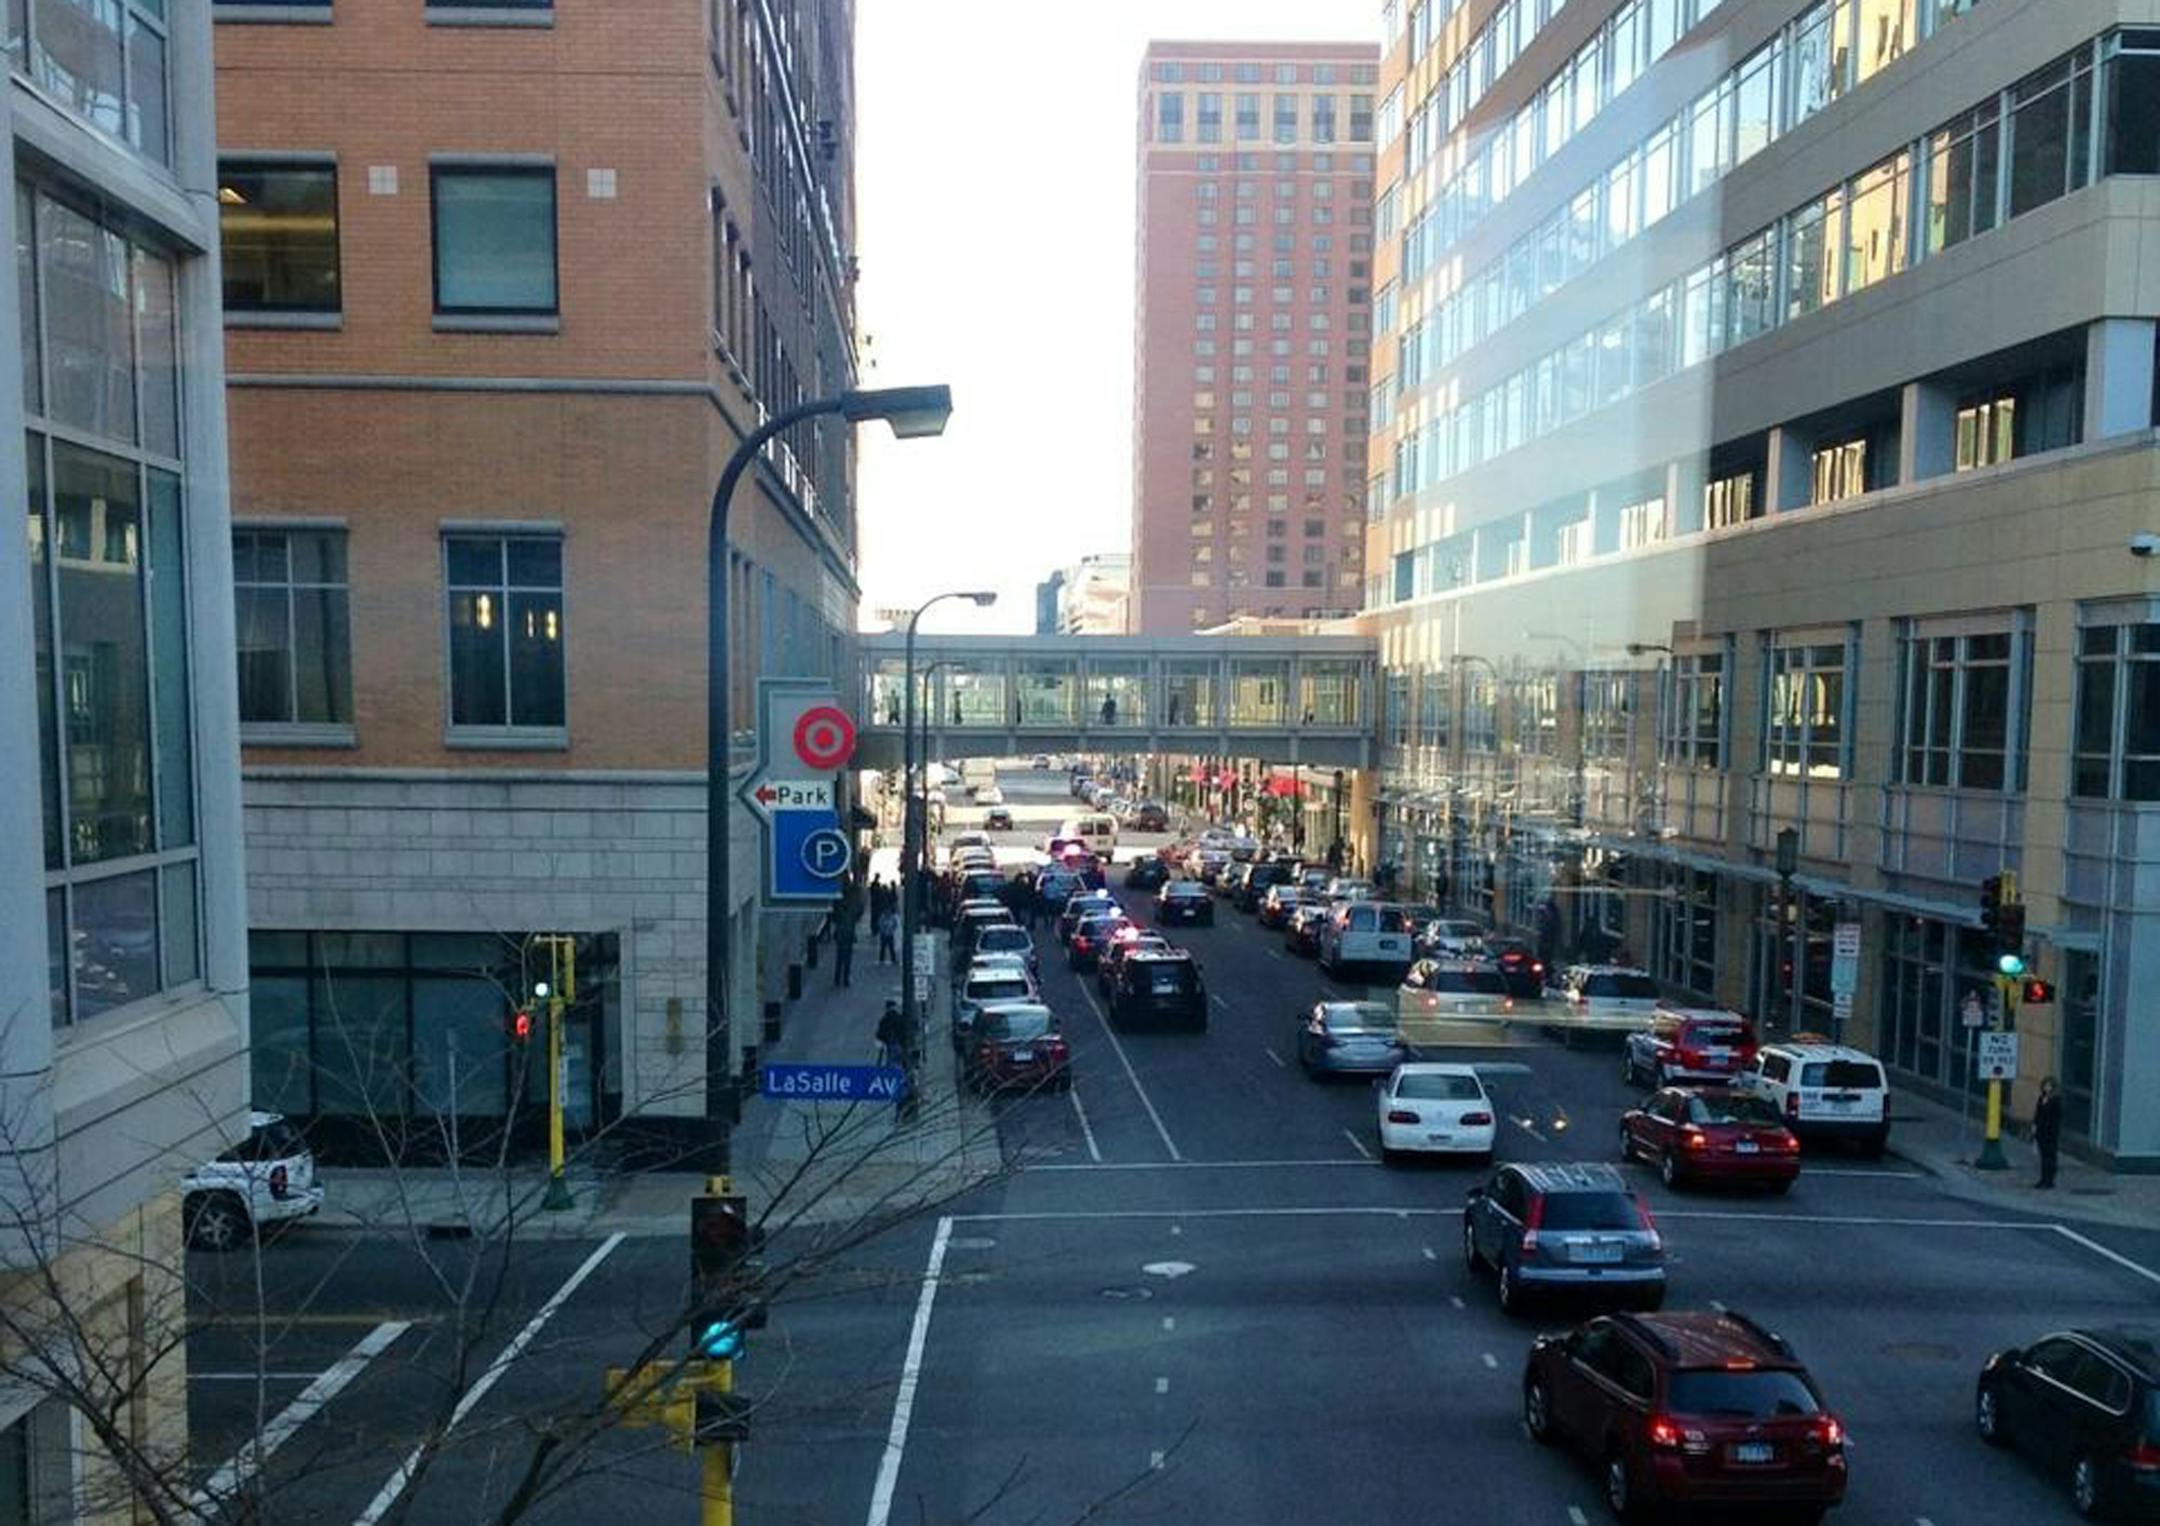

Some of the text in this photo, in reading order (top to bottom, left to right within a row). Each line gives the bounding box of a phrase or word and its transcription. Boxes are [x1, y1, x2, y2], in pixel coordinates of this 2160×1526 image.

[778, 786, 827, 805] Park
[816, 840, 838, 868] P
[768, 1071, 897, 1096] LaSalle Av
